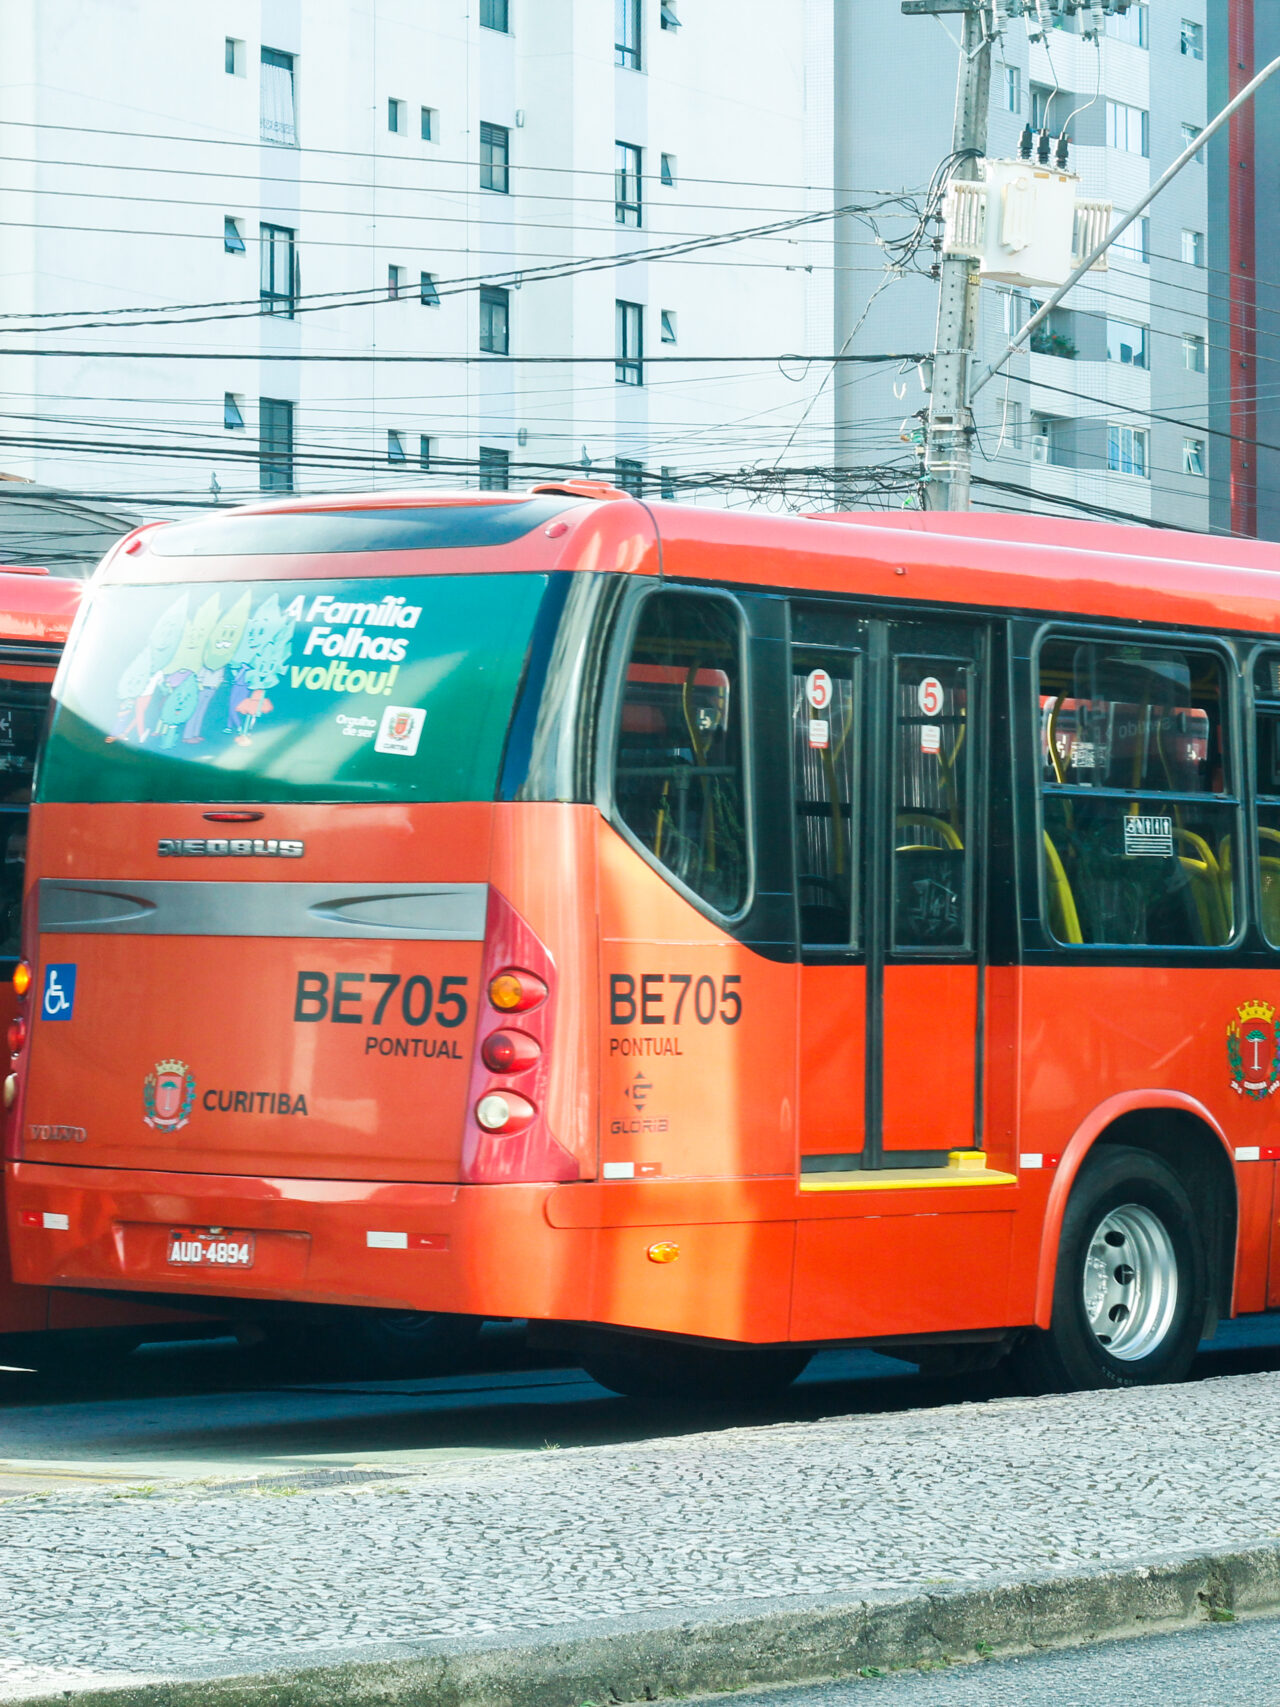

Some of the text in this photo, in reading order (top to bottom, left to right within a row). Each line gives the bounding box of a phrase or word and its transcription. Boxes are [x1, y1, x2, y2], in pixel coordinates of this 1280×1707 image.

[284, 594, 423, 628] A Família
[302, 626, 410, 662] Folhas
[290, 659, 401, 696] voltou!
[812, 674, 827, 705] 5
[923, 682, 938, 712] 5
[157, 838, 305, 858] NEOBUS
[293, 970, 468, 1028] BE705
[609, 973, 742, 1026] BE705
[365, 1037, 463, 1059] PONTUAL
[609, 1037, 684, 1057] PONTUAL
[202, 1089, 308, 1116] CURITIBA
